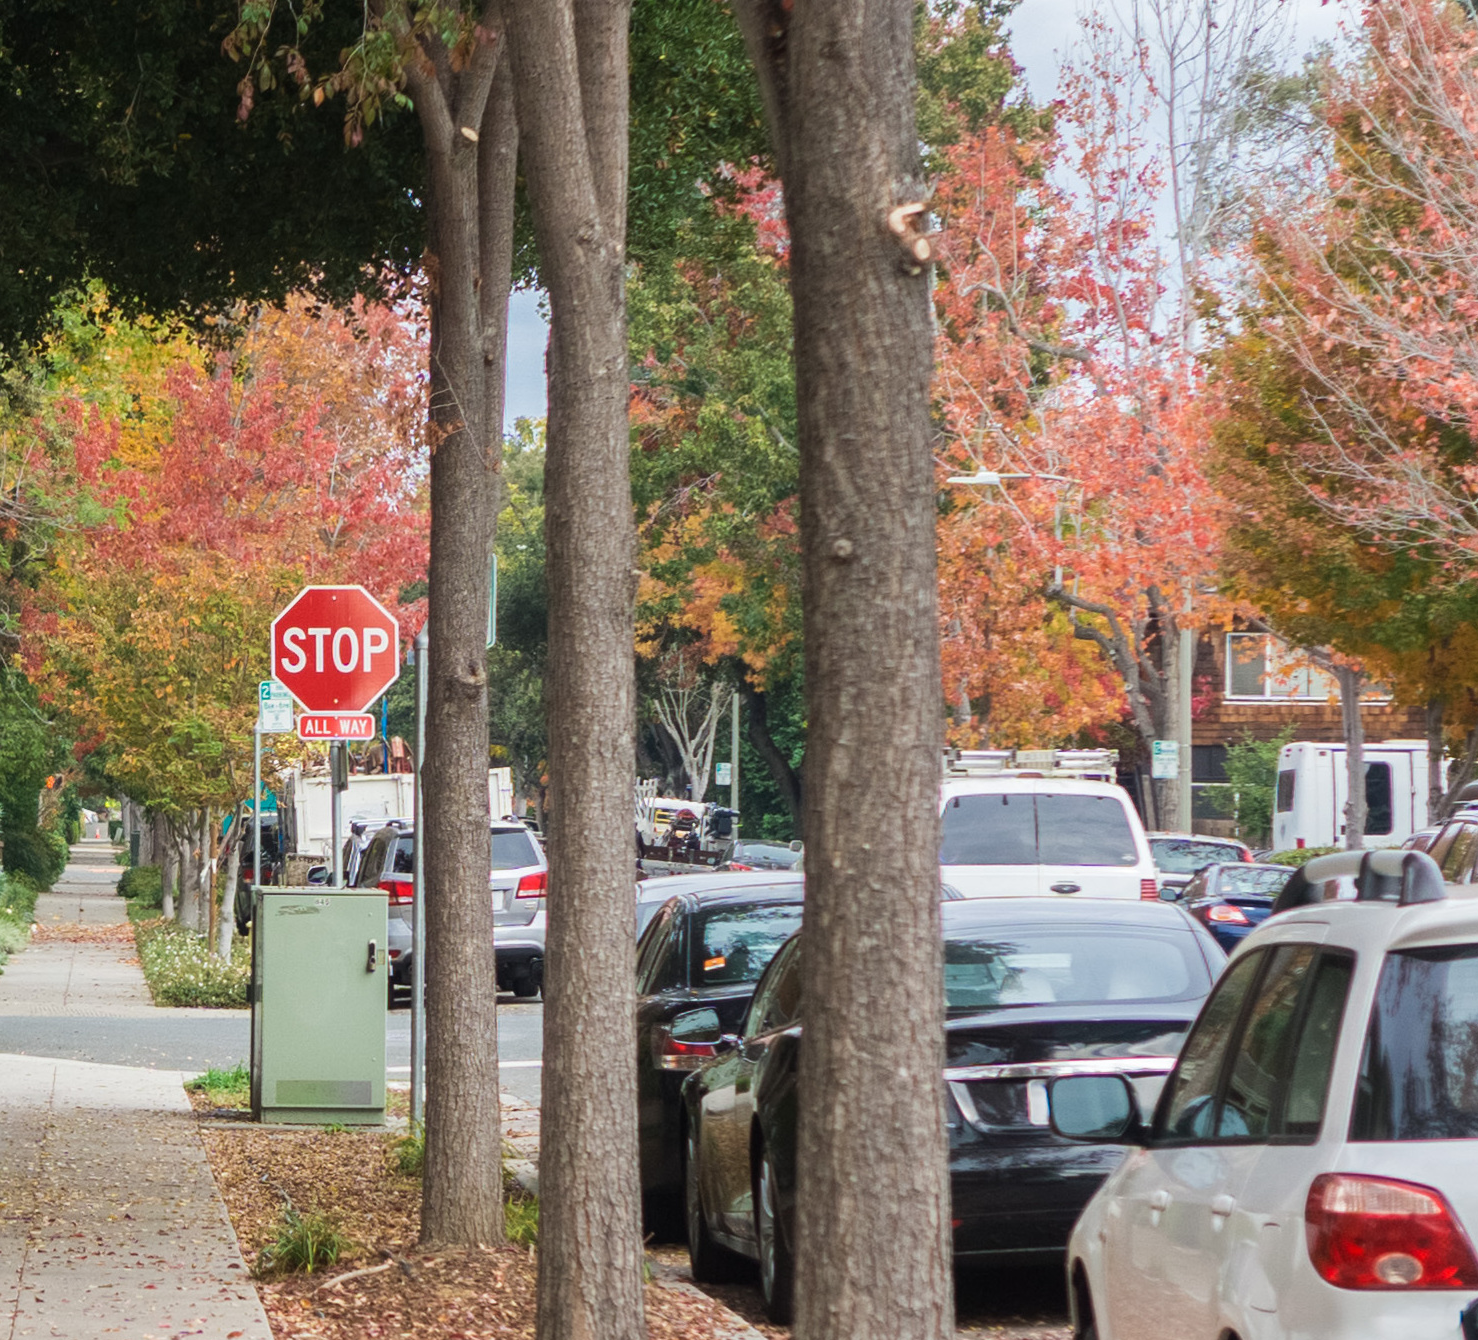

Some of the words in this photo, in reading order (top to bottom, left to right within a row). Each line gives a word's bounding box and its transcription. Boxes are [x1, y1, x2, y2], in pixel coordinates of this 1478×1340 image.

[281, 627, 389, 673] STOP
[262, 685, 270, 698] 2
[305, 719, 331, 735] ALL
[340, 719, 368, 735] WAY
